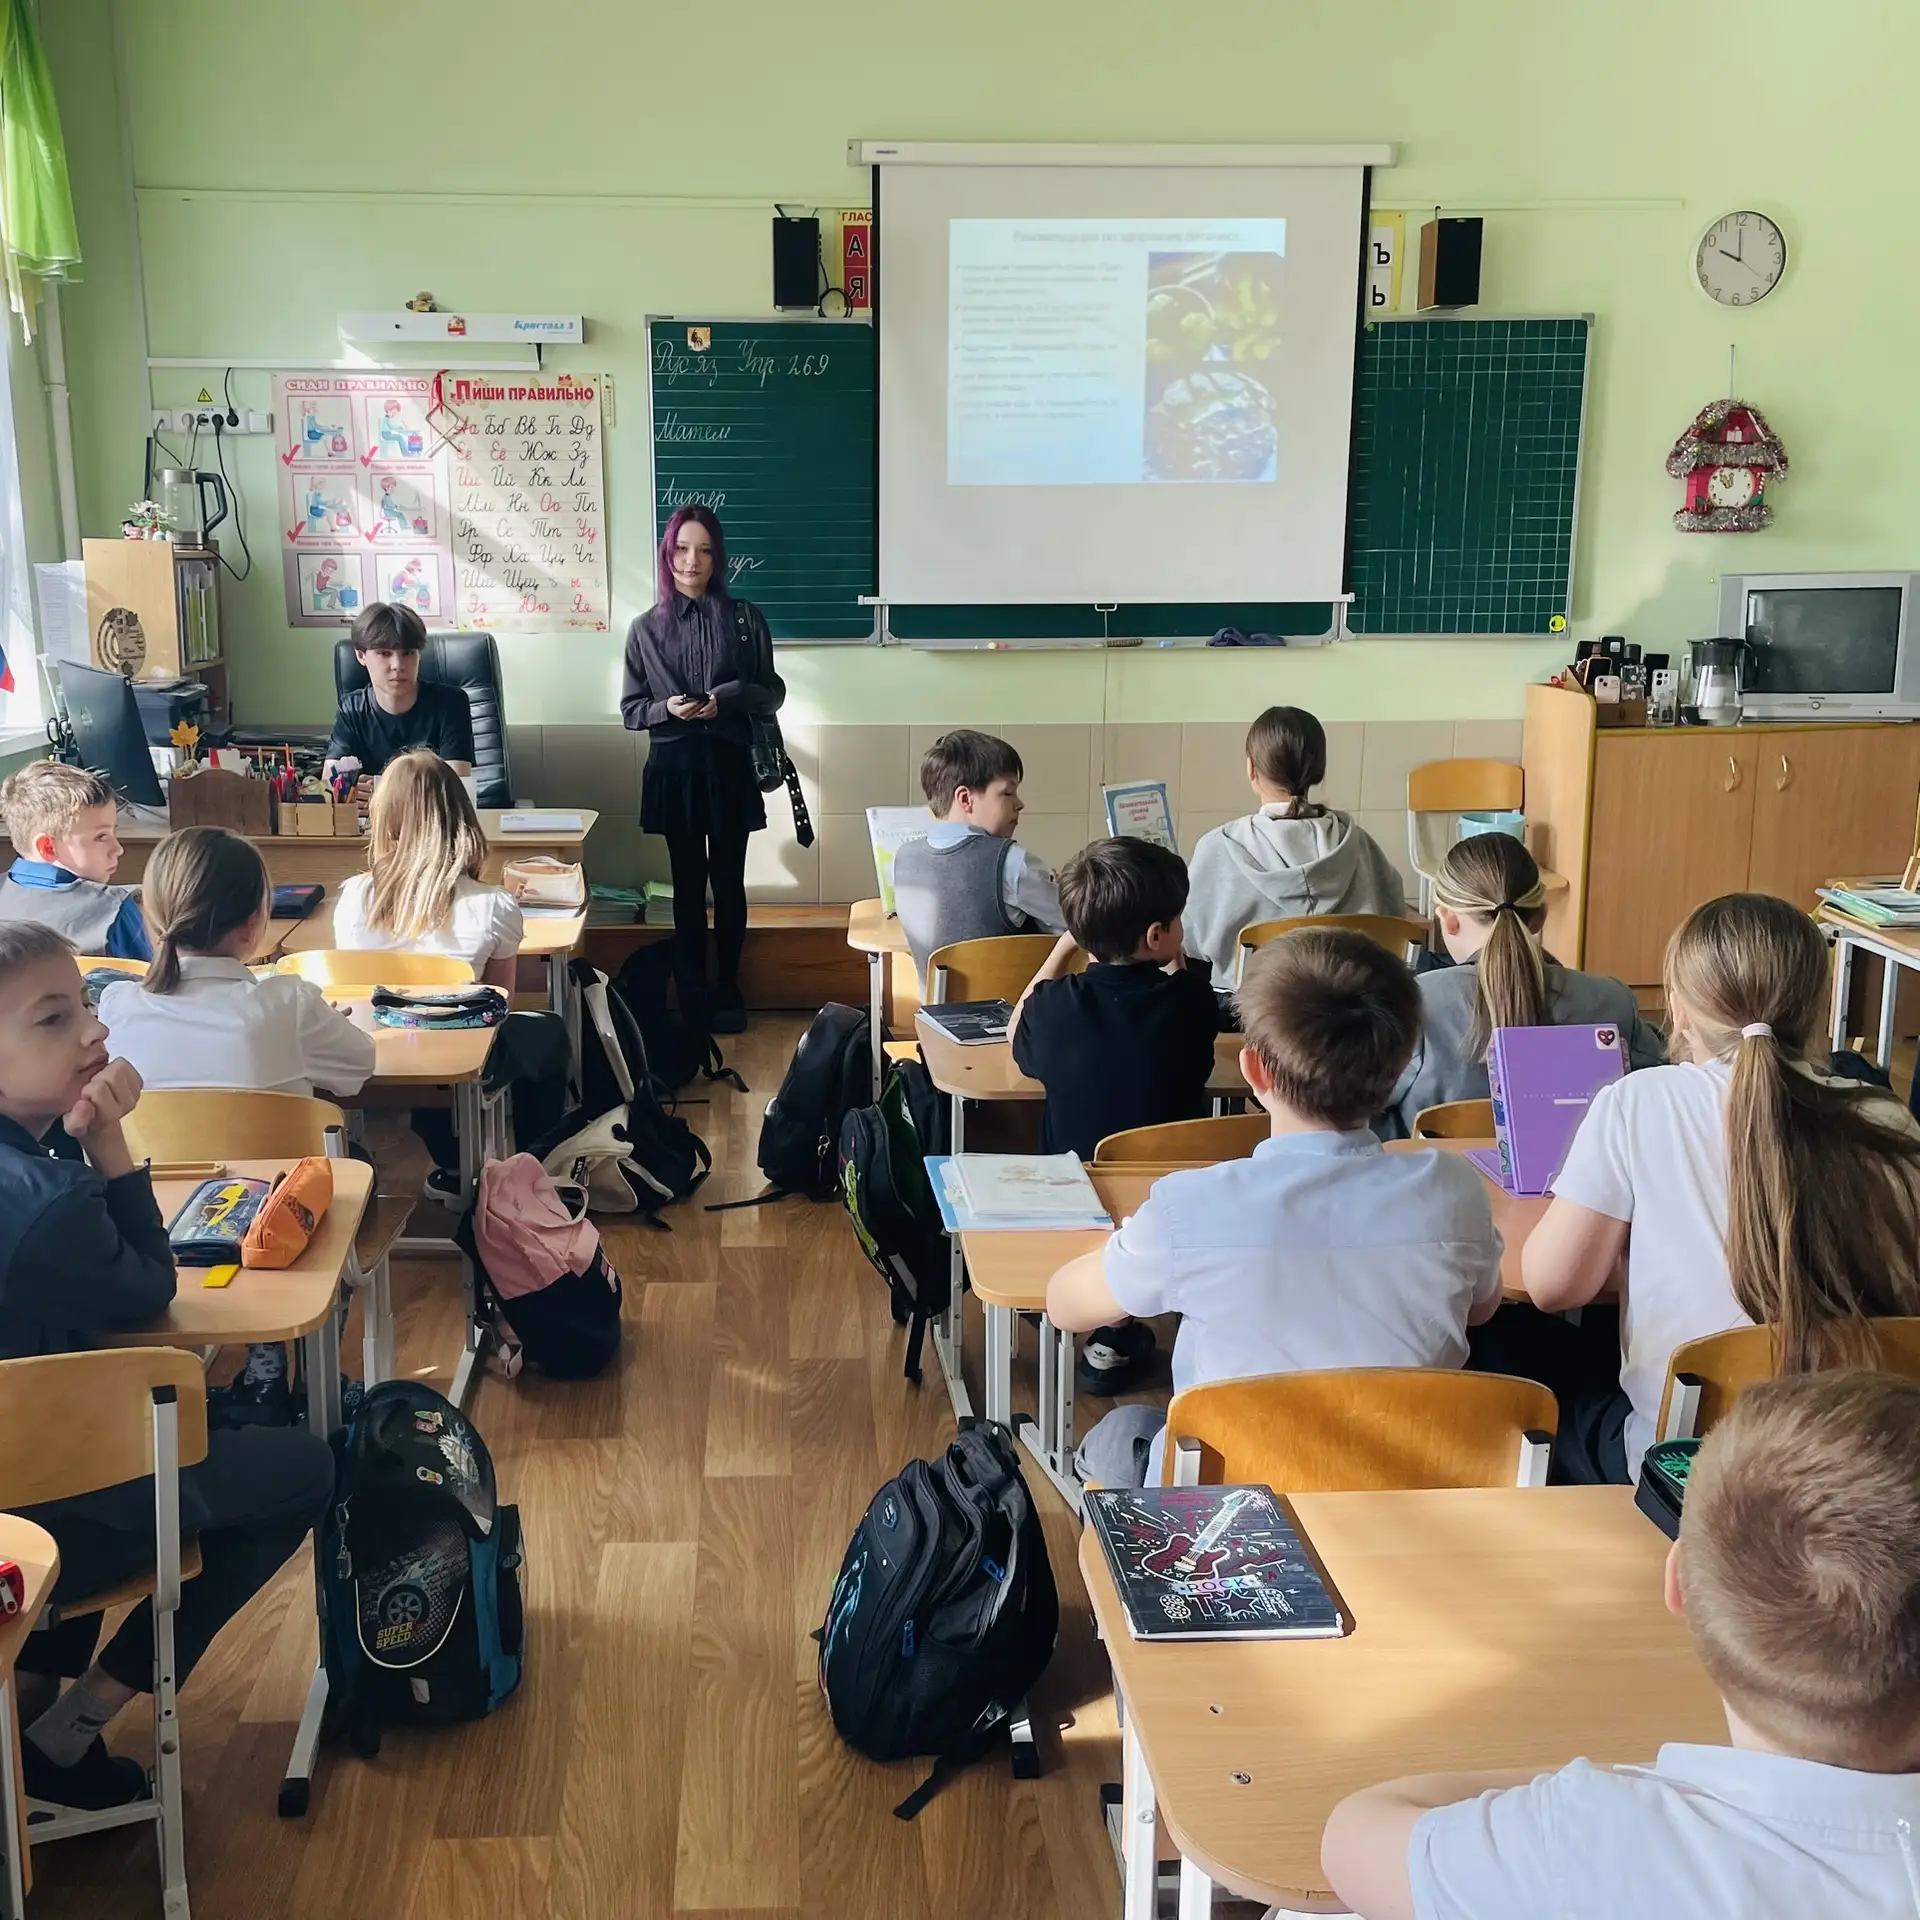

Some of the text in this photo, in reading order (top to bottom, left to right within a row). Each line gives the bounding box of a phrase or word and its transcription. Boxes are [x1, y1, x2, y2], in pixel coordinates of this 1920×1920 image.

[1719, 219, 1728, 233] 11
[1735, 213, 1748, 227] 12
[847, 234, 865, 257] А
[1703, 234, 1717, 248] 10
[1767, 232, 1777, 246] 2
[1772, 251, 1782, 265] 3
[1700, 274, 1709, 288] 8
[1764, 272, 1773, 285] 4
[849, 276, 865, 300] Я
[1713, 288, 1722, 301] 7
[1750, 286, 1759, 300] 5
[1731, 292, 1740, 306] 6
[788, 354, 830, 376] 269
[285, 380, 429, 392] СИДИ ПРАВИЛЬНО
[508, 387, 594, 401] ПРАВИЛЬНО
[485, 415, 510, 435] Бб
[515, 415, 537, 435] Вв
[569, 415, 596, 441] Дд
[655, 411, 731, 441] Матем
[519, 441, 558, 461] Жж
[568, 441, 590, 469] Зз
[456, 464, 586, 487] Ии Йй Кк Лл
[457, 492, 597, 512] Мм Нн Оо Пп
[662, 477, 727, 514] Литер
[457, 517, 598, 544] Рр Сс Тт Уу
[467, 543, 595, 568] Фф Хх Цц Чч
[461, 569, 496, 588] Шш
[503, 569, 540, 592] Щщ
[467, 593, 592, 613] Ээ Юю Яя
[1186, 1577, 1250, 1592] ROCK
[377, 1621, 413, 1640] SUPER
[376, 1631, 412, 1649] SPEED
